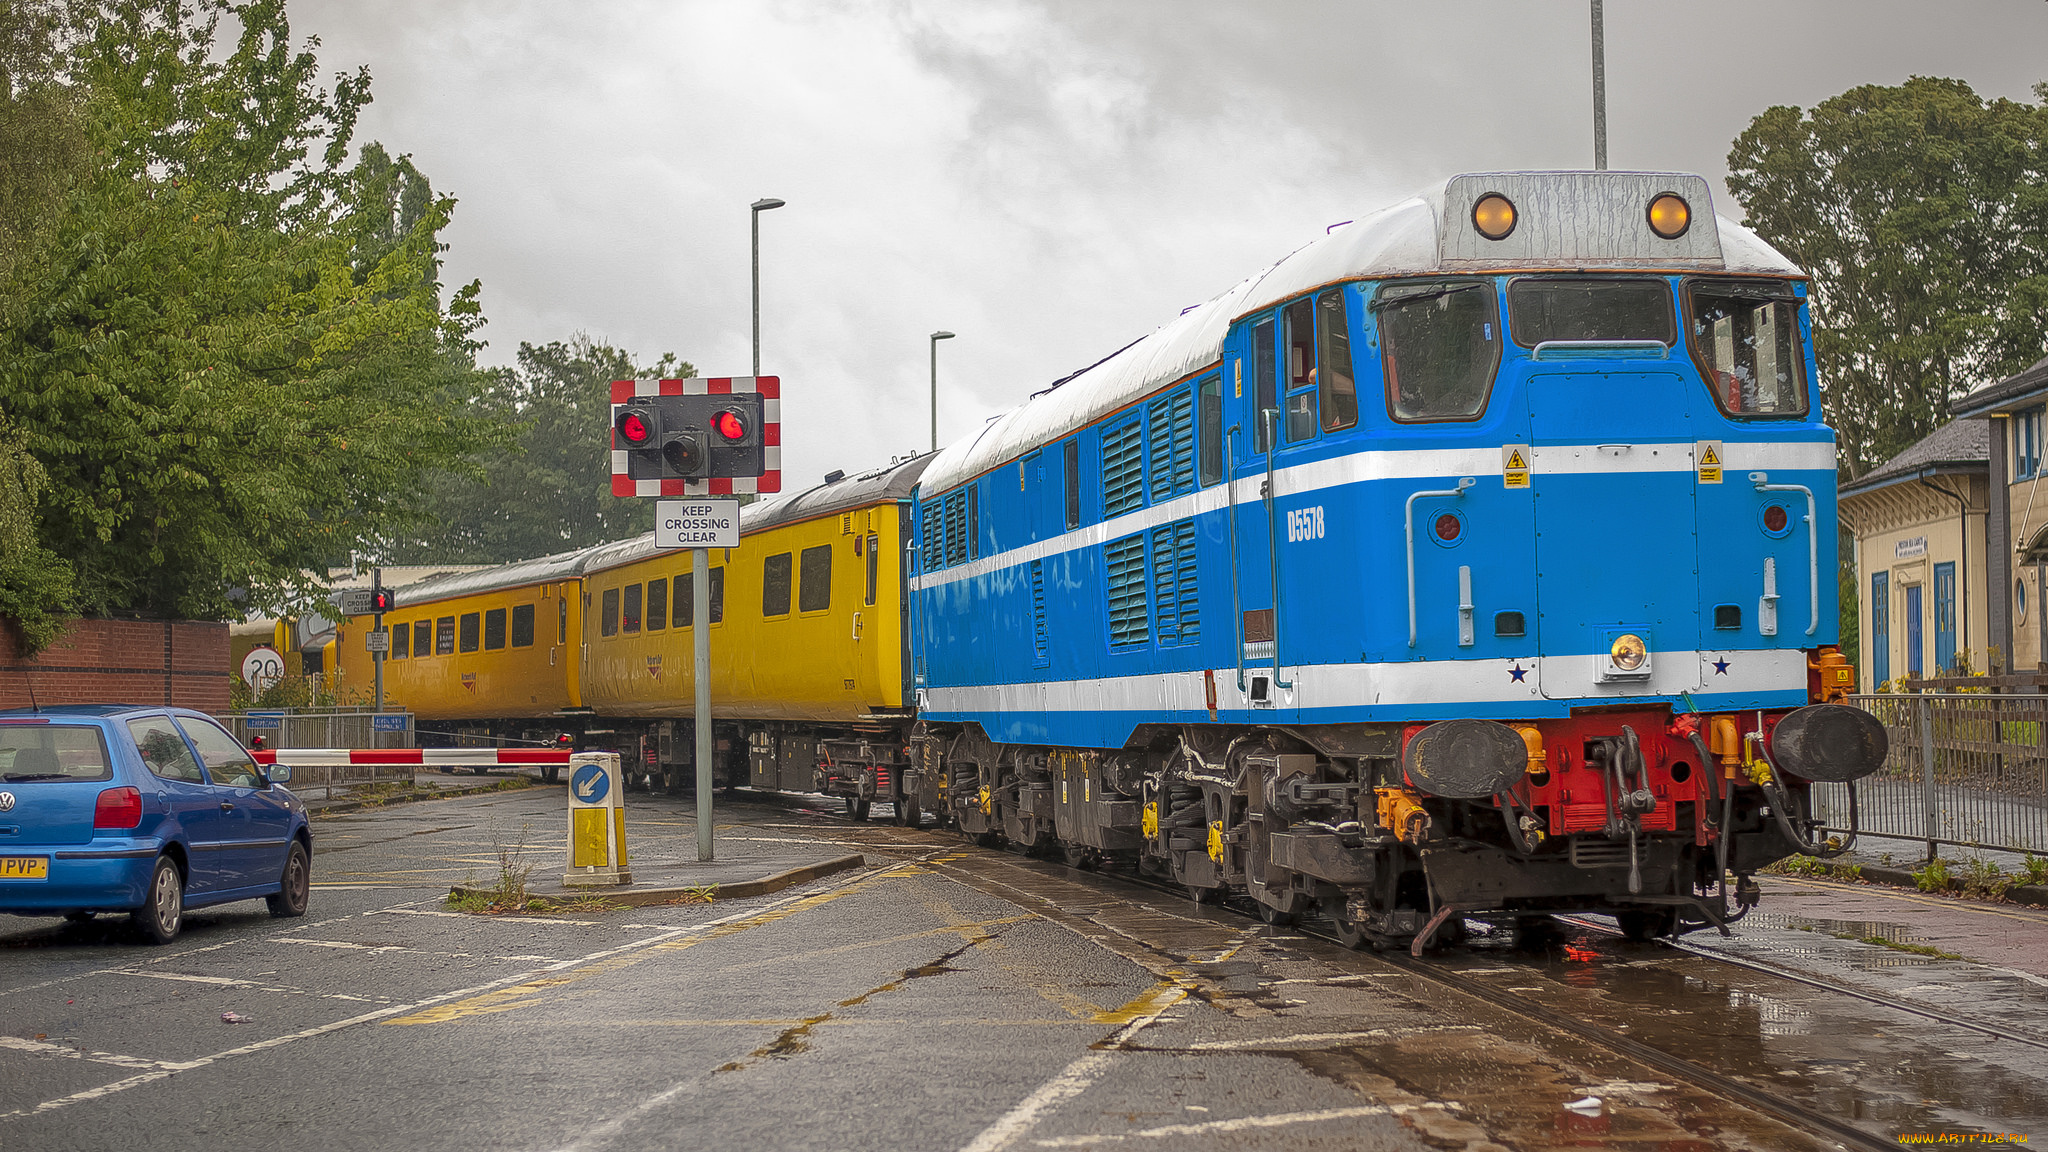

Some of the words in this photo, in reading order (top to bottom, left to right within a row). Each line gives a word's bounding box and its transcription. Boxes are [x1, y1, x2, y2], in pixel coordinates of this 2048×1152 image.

[682, 506, 712, 516] KEEP
[665, 519, 729, 529] CROSSING
[1287, 505, 1325, 543] D5578
[678, 532, 716, 542] CLEAR
[251, 659, 277, 680] 20
[6, 859, 37, 874] PVP
